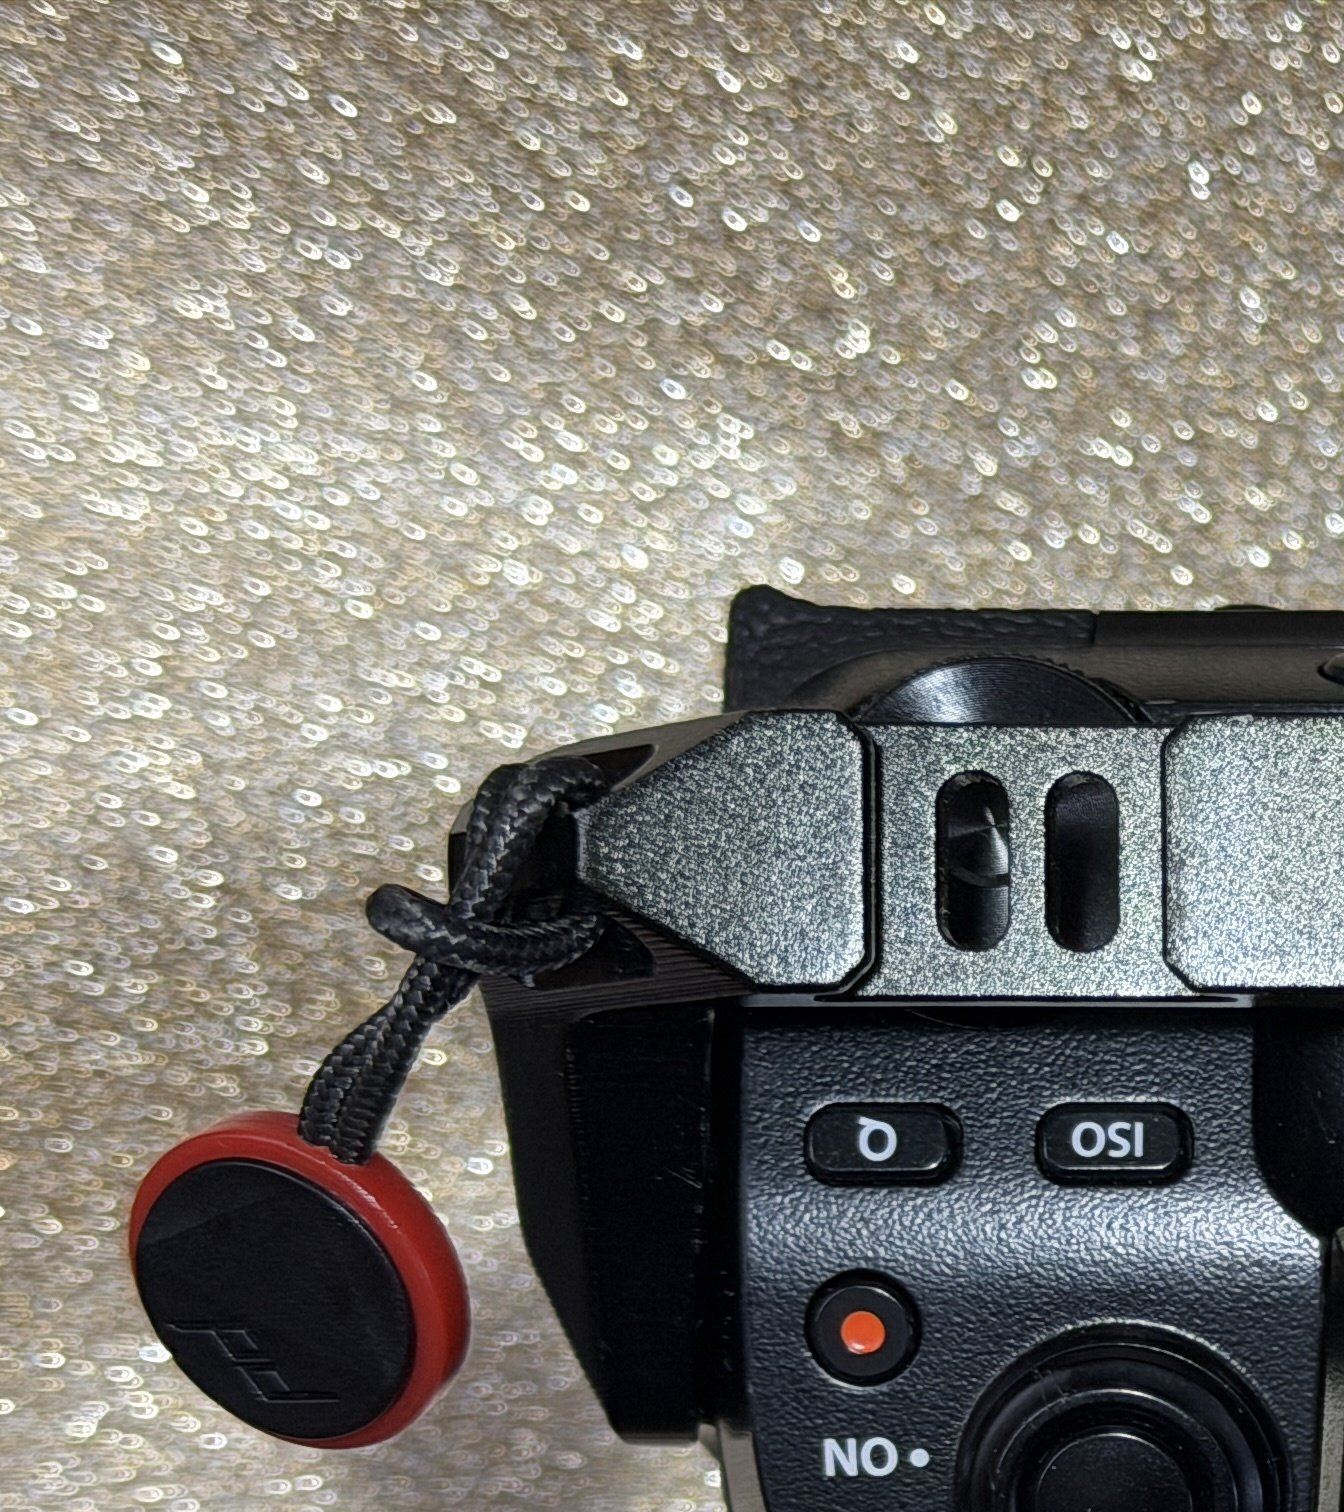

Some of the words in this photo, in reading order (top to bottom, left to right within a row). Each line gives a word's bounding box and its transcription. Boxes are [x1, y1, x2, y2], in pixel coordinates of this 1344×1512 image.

[856, 1116, 898, 1162] Q
[1070, 1120, 1144, 1158] ISO
[823, 1437, 899, 1476] ON
